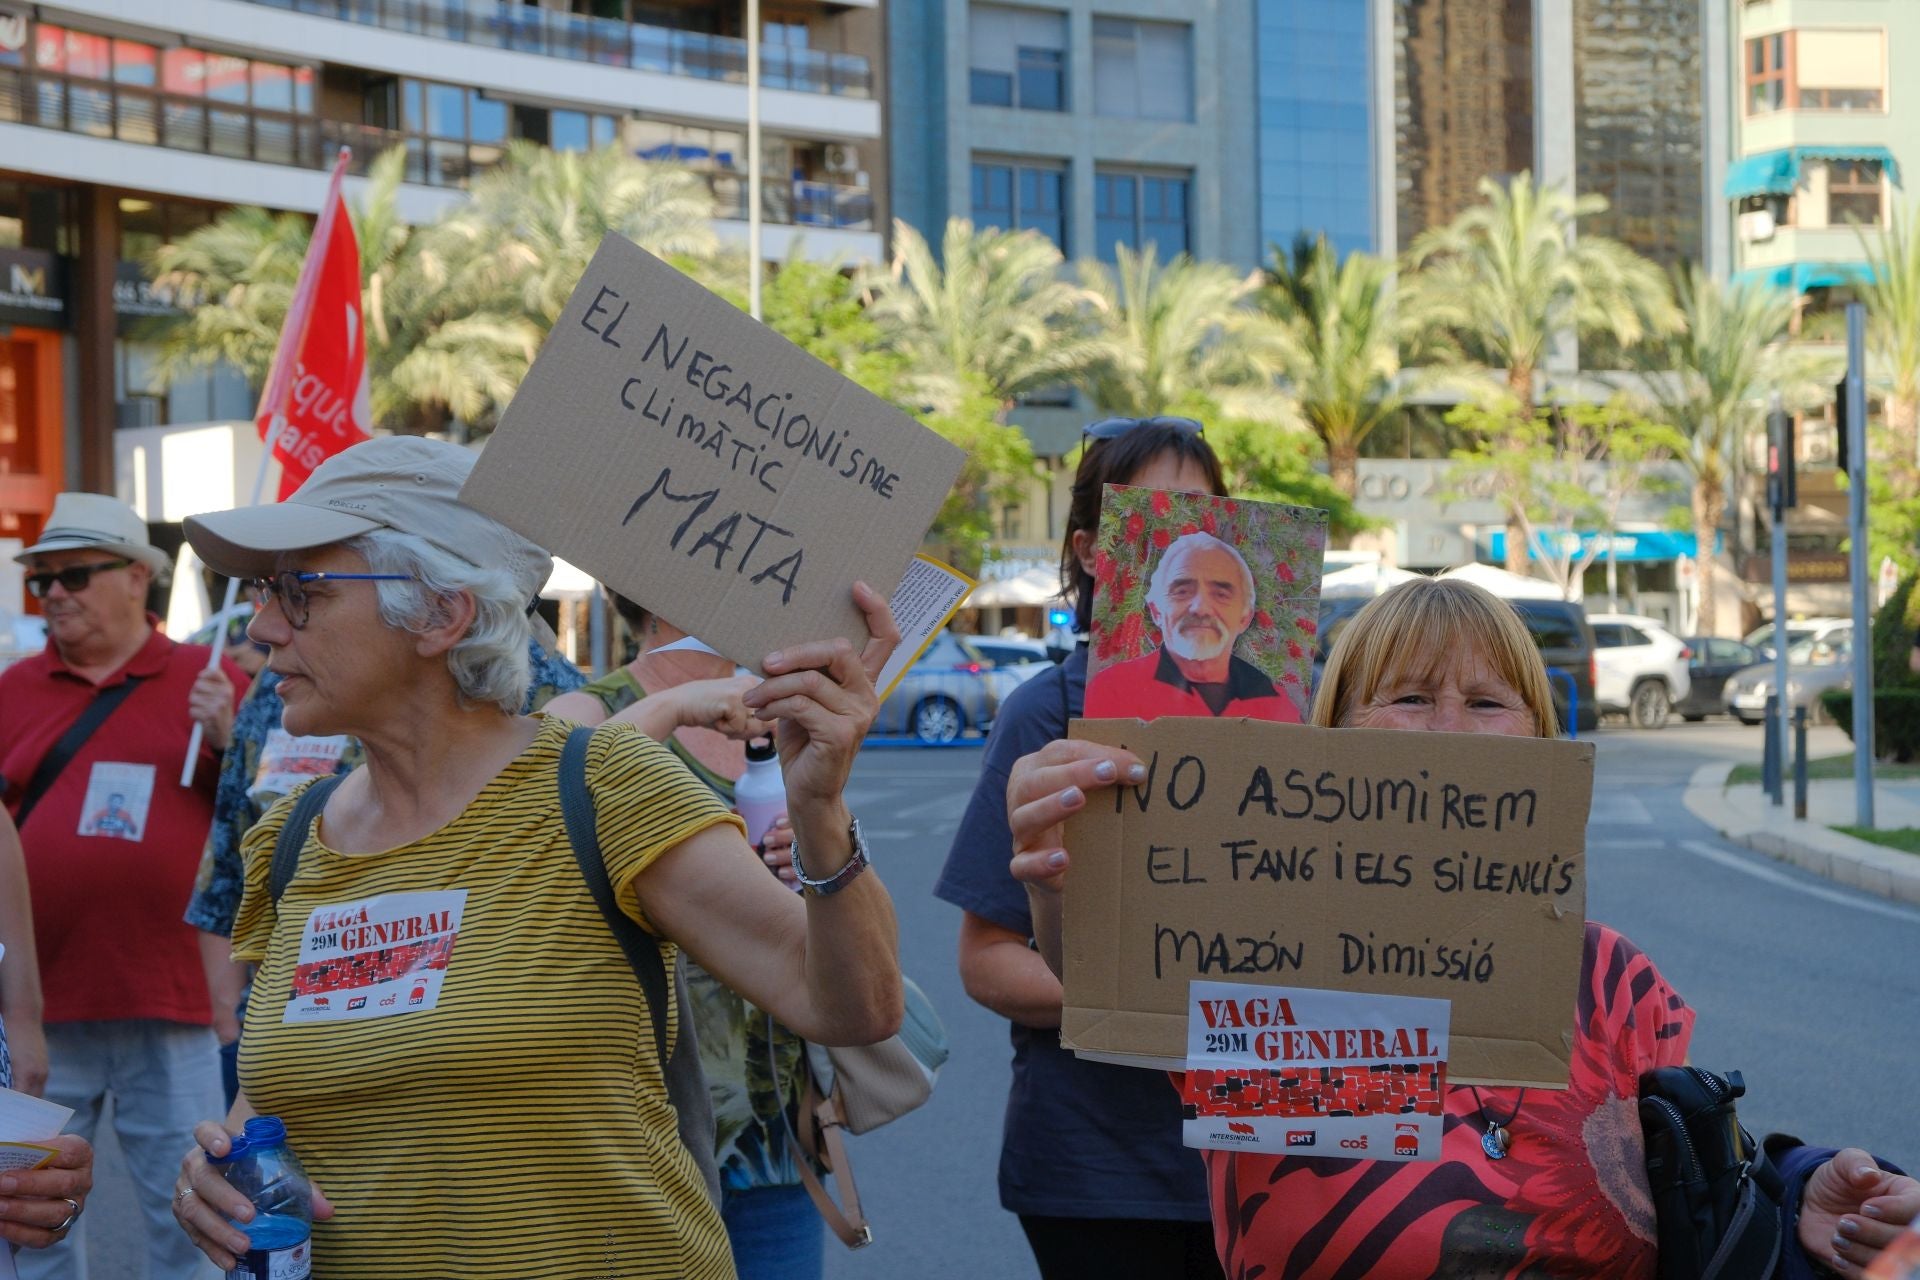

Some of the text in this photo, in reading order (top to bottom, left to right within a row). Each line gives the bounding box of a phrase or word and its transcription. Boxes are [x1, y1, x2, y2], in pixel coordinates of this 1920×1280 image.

[581, 285, 629, 348] EL
[622, 467, 803, 606] MATA
[1116, 744, 1206, 814] NO
[1147, 844, 1206, 884] EL
[1221, 839, 1317, 882] FANG
[311, 910, 454, 952] 29M GENERAL
[312, 905, 369, 933] VAGA
[1155, 922, 1304, 979] MAZÓN
[349, 1000, 366, 1009] CNT
[1198, 998, 1298, 1029] VAGA
[1206, 1028, 1439, 1061] 29M GENERAL
[1209, 1132, 1260, 1144] INTERSINDICAL
[1288, 1133, 1313, 1144] CNT
[1395, 1146, 1417, 1156] CGT
